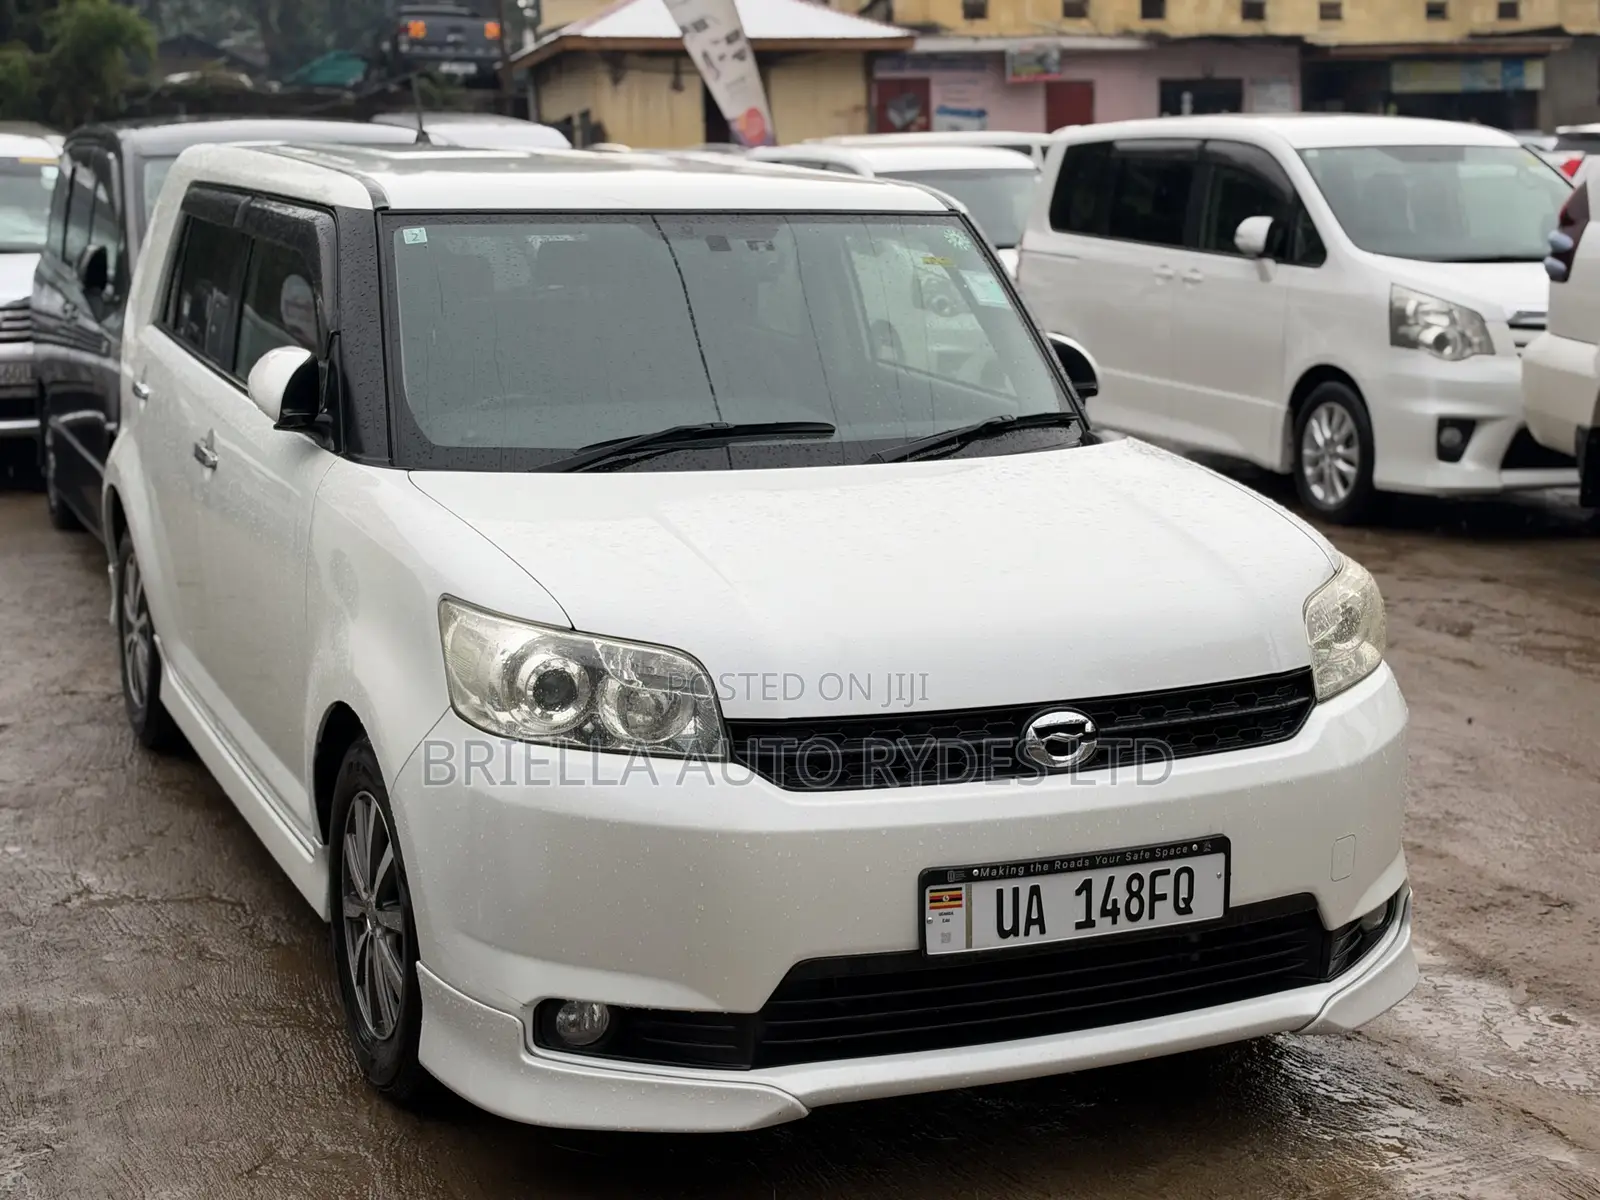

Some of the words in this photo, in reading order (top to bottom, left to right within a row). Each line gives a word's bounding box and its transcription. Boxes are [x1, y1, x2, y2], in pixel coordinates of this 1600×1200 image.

[980, 865, 1025, 878] Making
[1030, 861, 1049, 873] the
[1054, 857, 1091, 870] Roads
[1094, 854, 1121, 865] Your
[1125, 849, 1151, 861] Safe
[1155, 845, 1188, 859] Space
[996, 883, 1047, 940] UA
[1074, 865, 1195, 931] 148FQ
